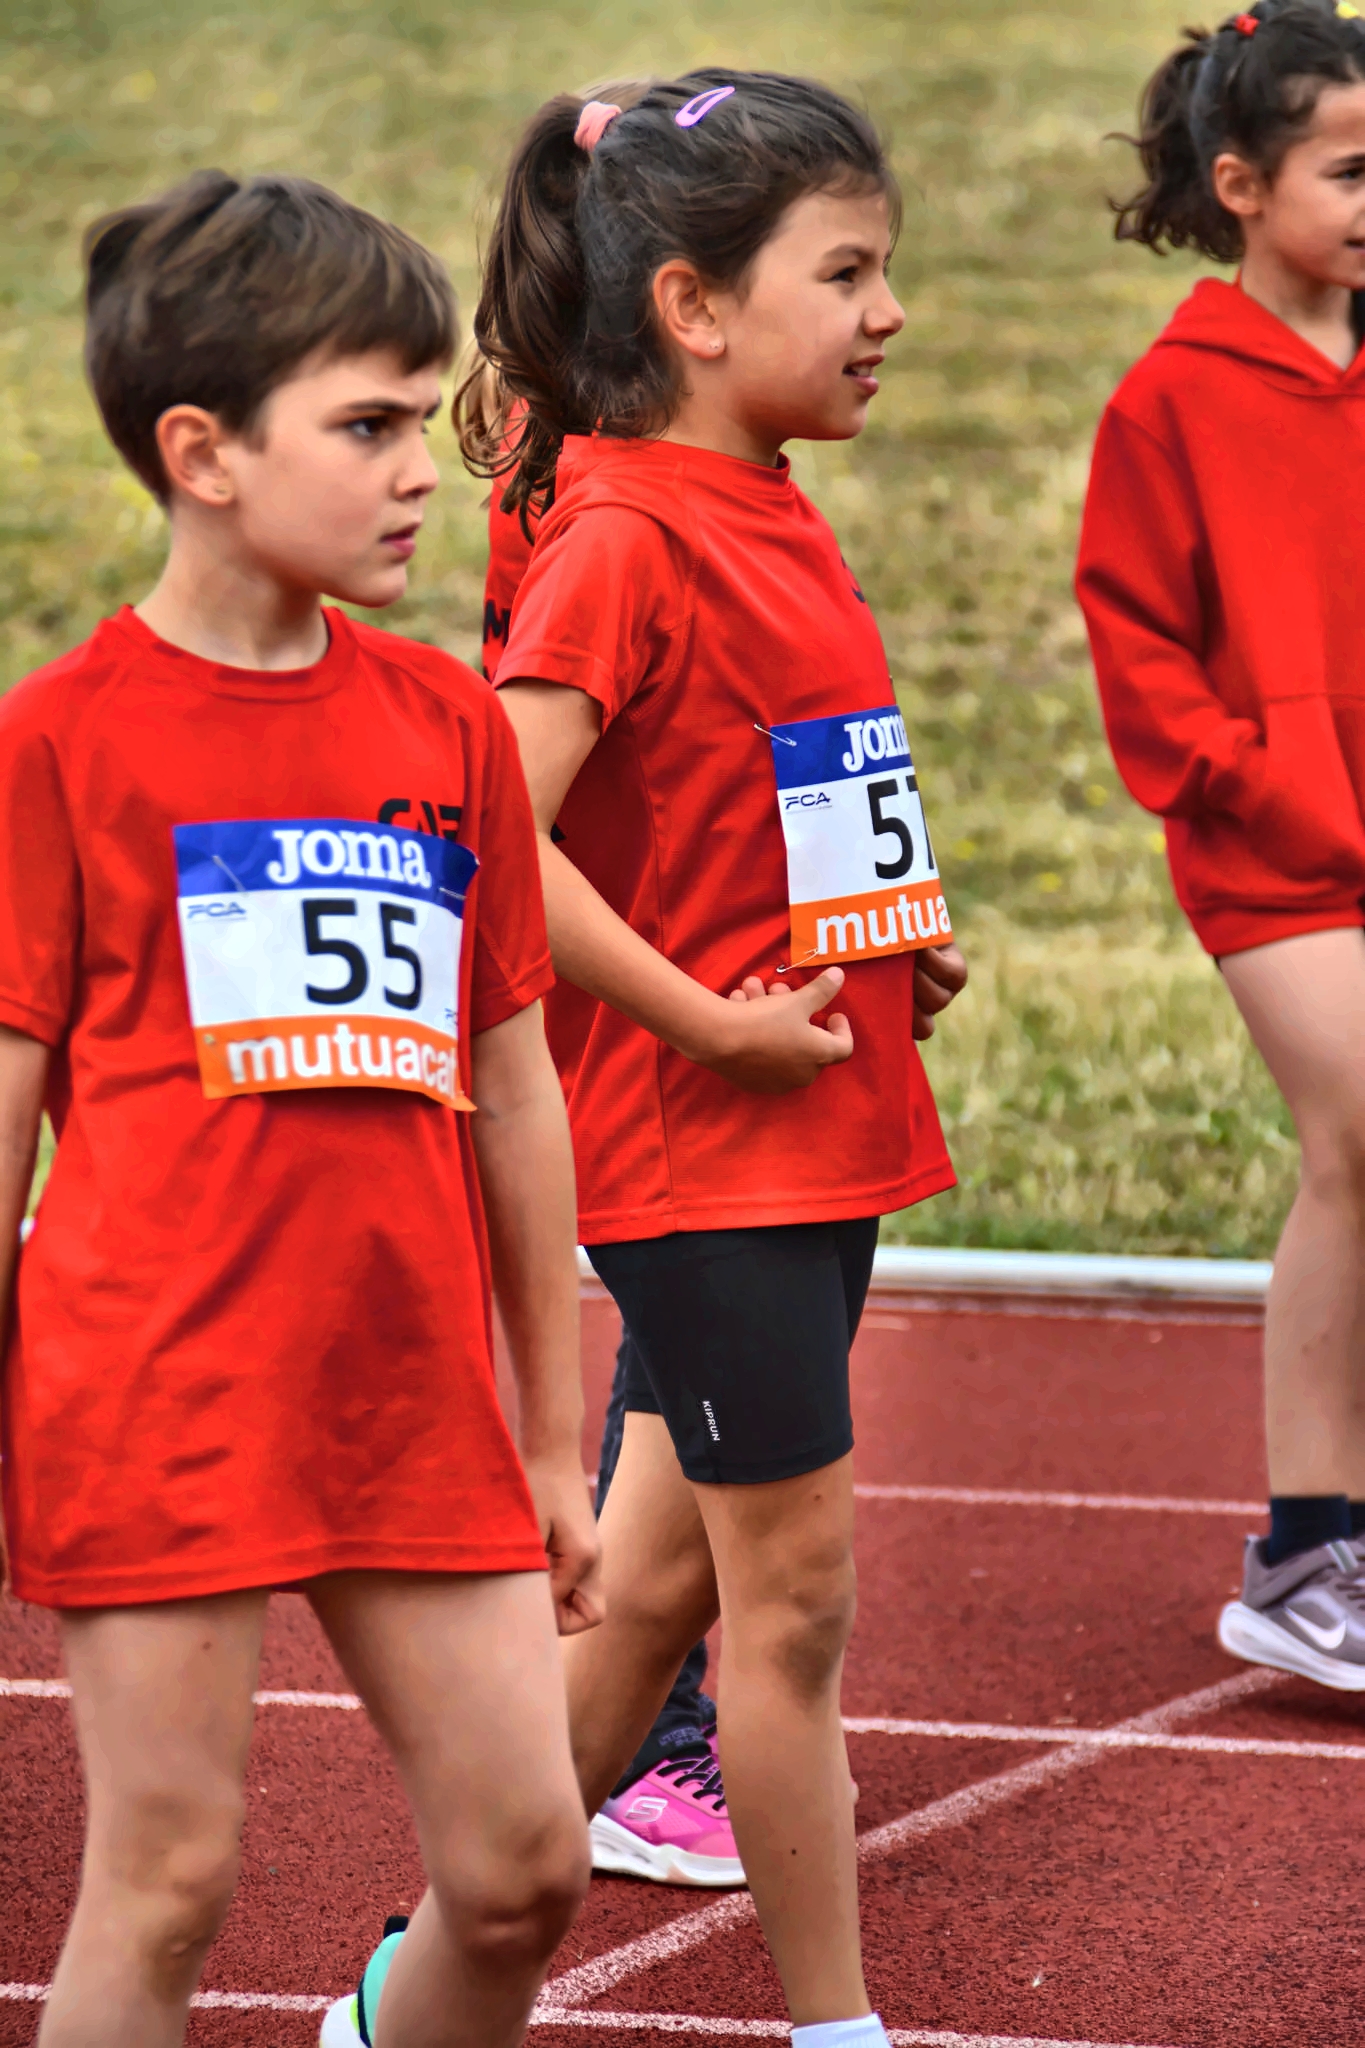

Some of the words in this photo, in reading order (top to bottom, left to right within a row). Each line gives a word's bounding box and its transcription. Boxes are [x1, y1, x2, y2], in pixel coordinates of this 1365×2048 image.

[785, 792, 831, 810] FCA
[266, 829, 433, 889] Joma
[187, 902, 247, 919] FCA
[816, 894, 953, 955] mutua
[302, 898, 423, 1012] 55
[702, 1400, 721, 1441] KIPRUN
